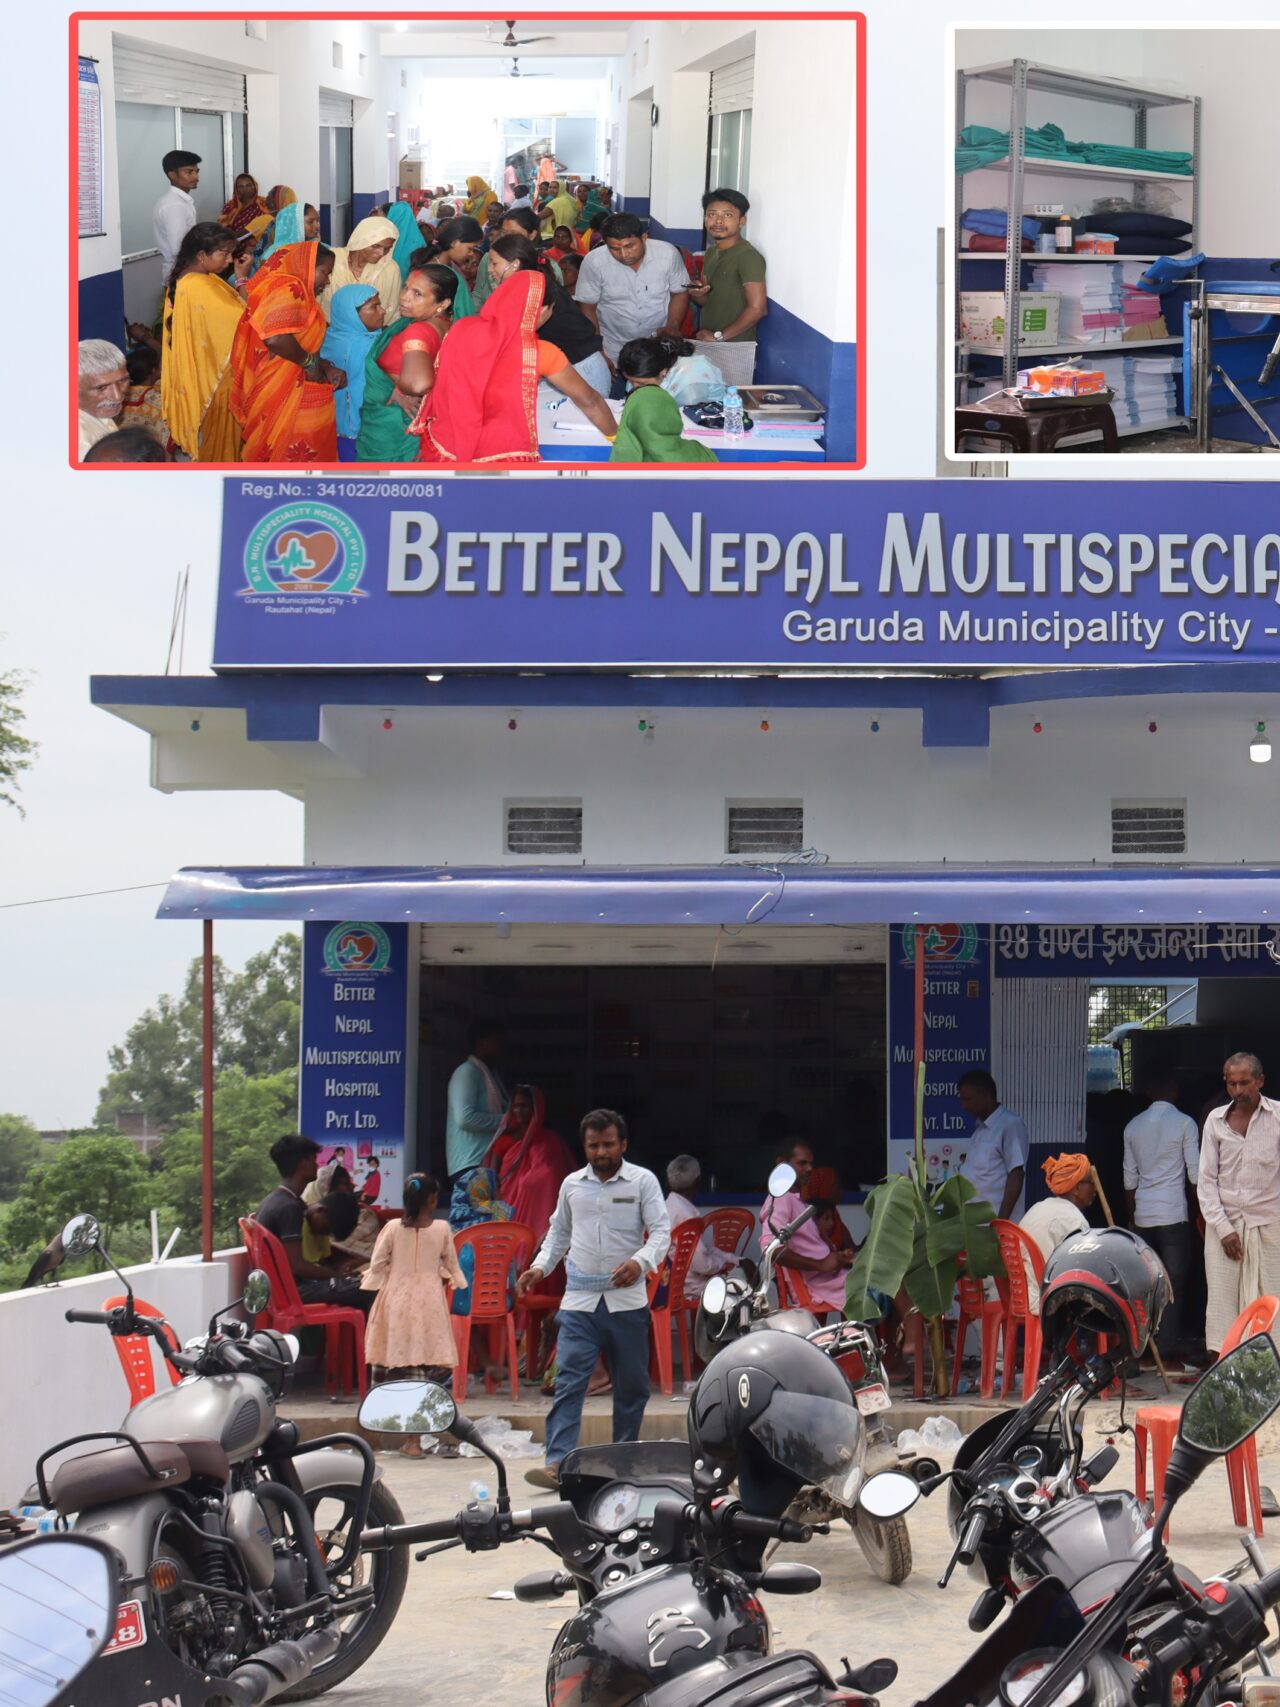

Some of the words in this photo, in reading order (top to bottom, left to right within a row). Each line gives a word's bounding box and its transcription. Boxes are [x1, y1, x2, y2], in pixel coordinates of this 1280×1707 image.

[316, 483, 443, 498] 341022/080/081
[312, 508, 353, 538] HOSPITAL
[385, 511, 623, 593] BETTER
[650, 511, 860, 604] NEPAL
[782, 609, 924, 643] Garuda
[939, 610, 1164, 651] Municipality
[1178, 610, 1251, 651] City
[1264, 626, 1279, 634] -
[1217, 925, 1261, 962] सवा
[334, 983, 376, 1002] BETTER
[335, 1015, 373, 1035] NEPAL
[305, 1047, 402, 1067] MULTISPECIALITY
[894, 1045, 987, 1065] MUISPECIALITY
[325, 1079, 381, 1098] HOSPITAL
[326, 1110, 351, 1129] PVT.
[355, 1110, 379, 1129] LTD.
[924, 1116, 940, 1131] VT.
[943, 1112, 967, 1131] LTD.
